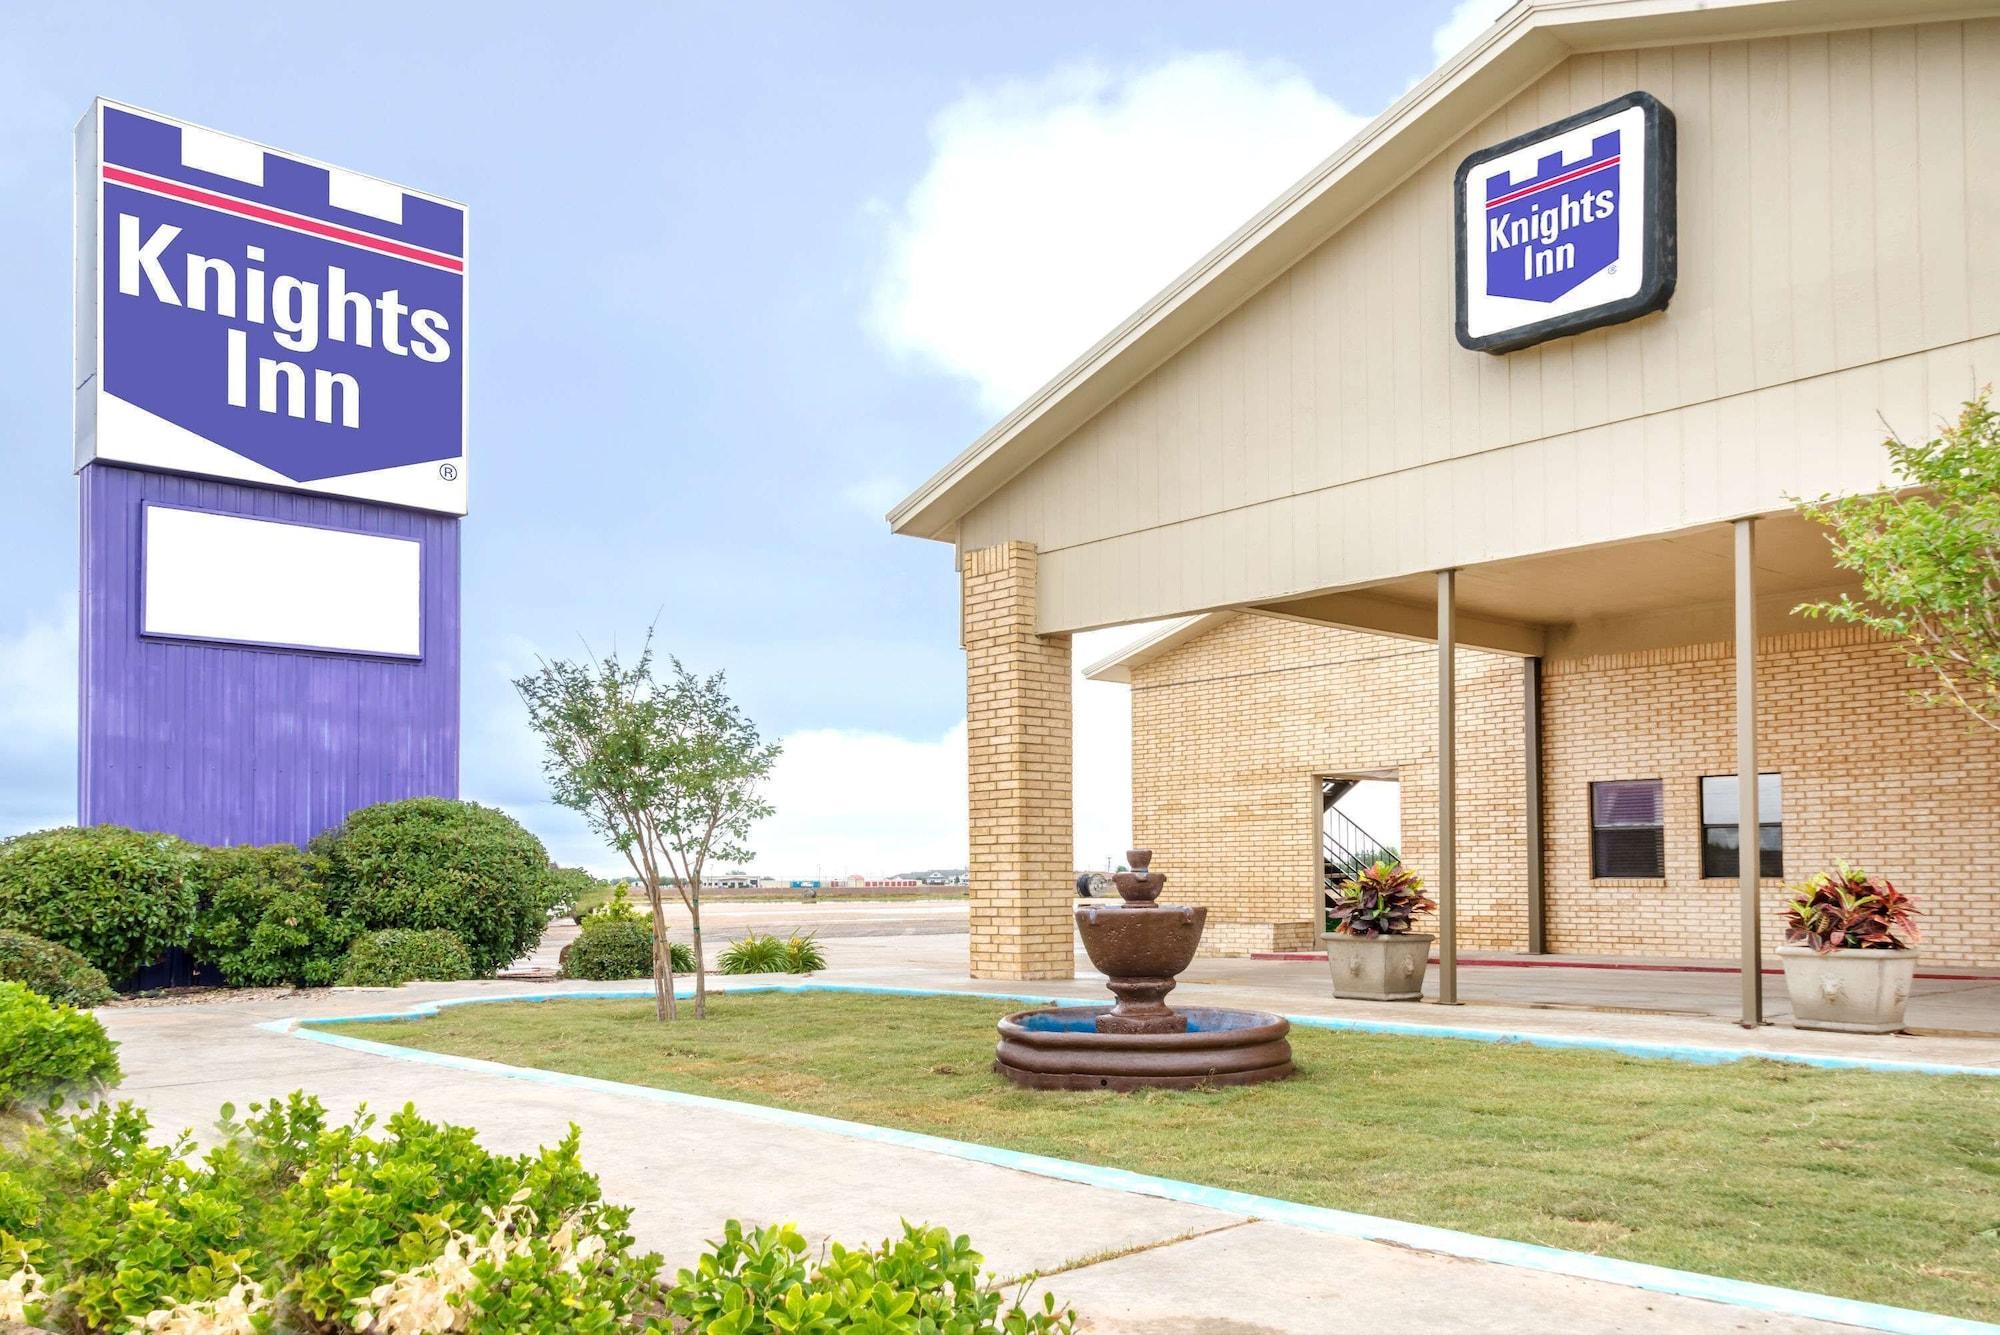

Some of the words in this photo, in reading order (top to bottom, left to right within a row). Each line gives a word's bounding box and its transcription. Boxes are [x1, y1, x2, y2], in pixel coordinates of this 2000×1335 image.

[1489, 189, 1615, 253] Knights
[1524, 242, 1575, 281] Inn
[119, 212, 451, 364] Knights
[227, 327, 360, 429] Inn
